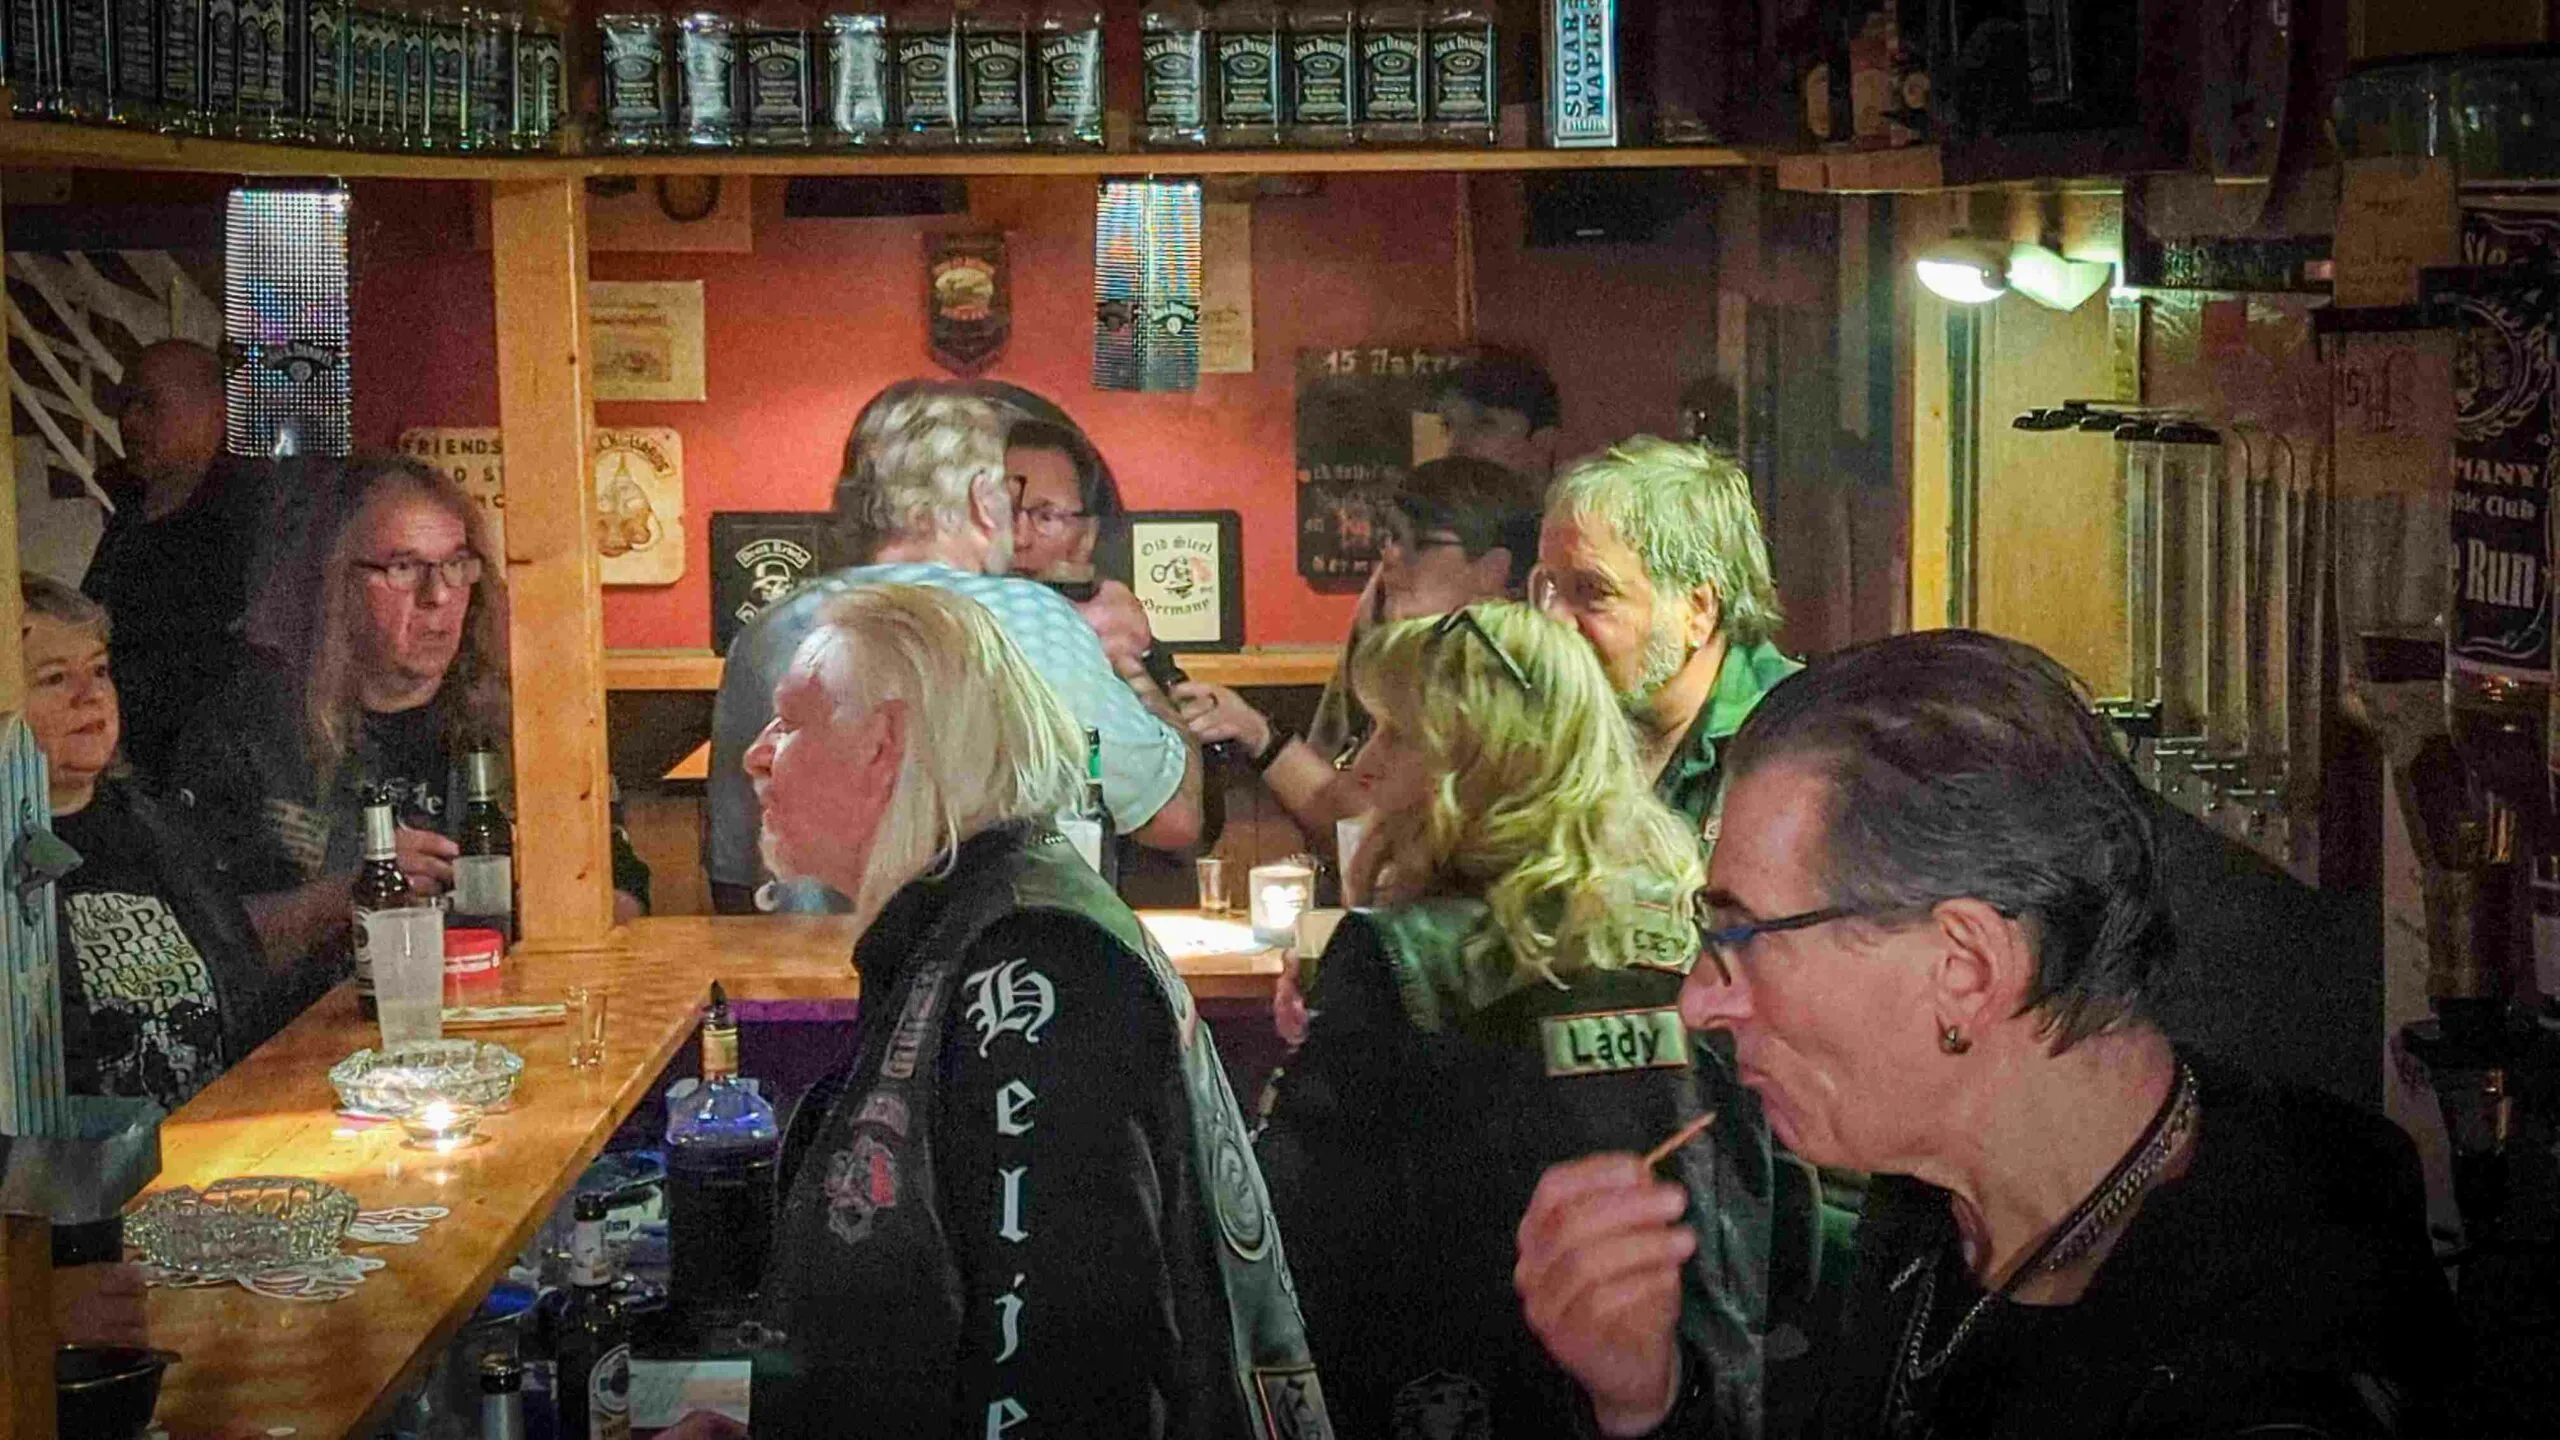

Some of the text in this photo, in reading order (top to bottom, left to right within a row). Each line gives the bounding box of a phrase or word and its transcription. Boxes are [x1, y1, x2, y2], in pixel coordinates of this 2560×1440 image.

[1563, 13, 1582, 117] SUGAR
[1585, 13, 1605, 117] MAPLE
[403, 438, 503, 455] FRIENDS
[2465, 538, 2536, 609] Run
[1567, 1018, 1661, 1065] Lady
